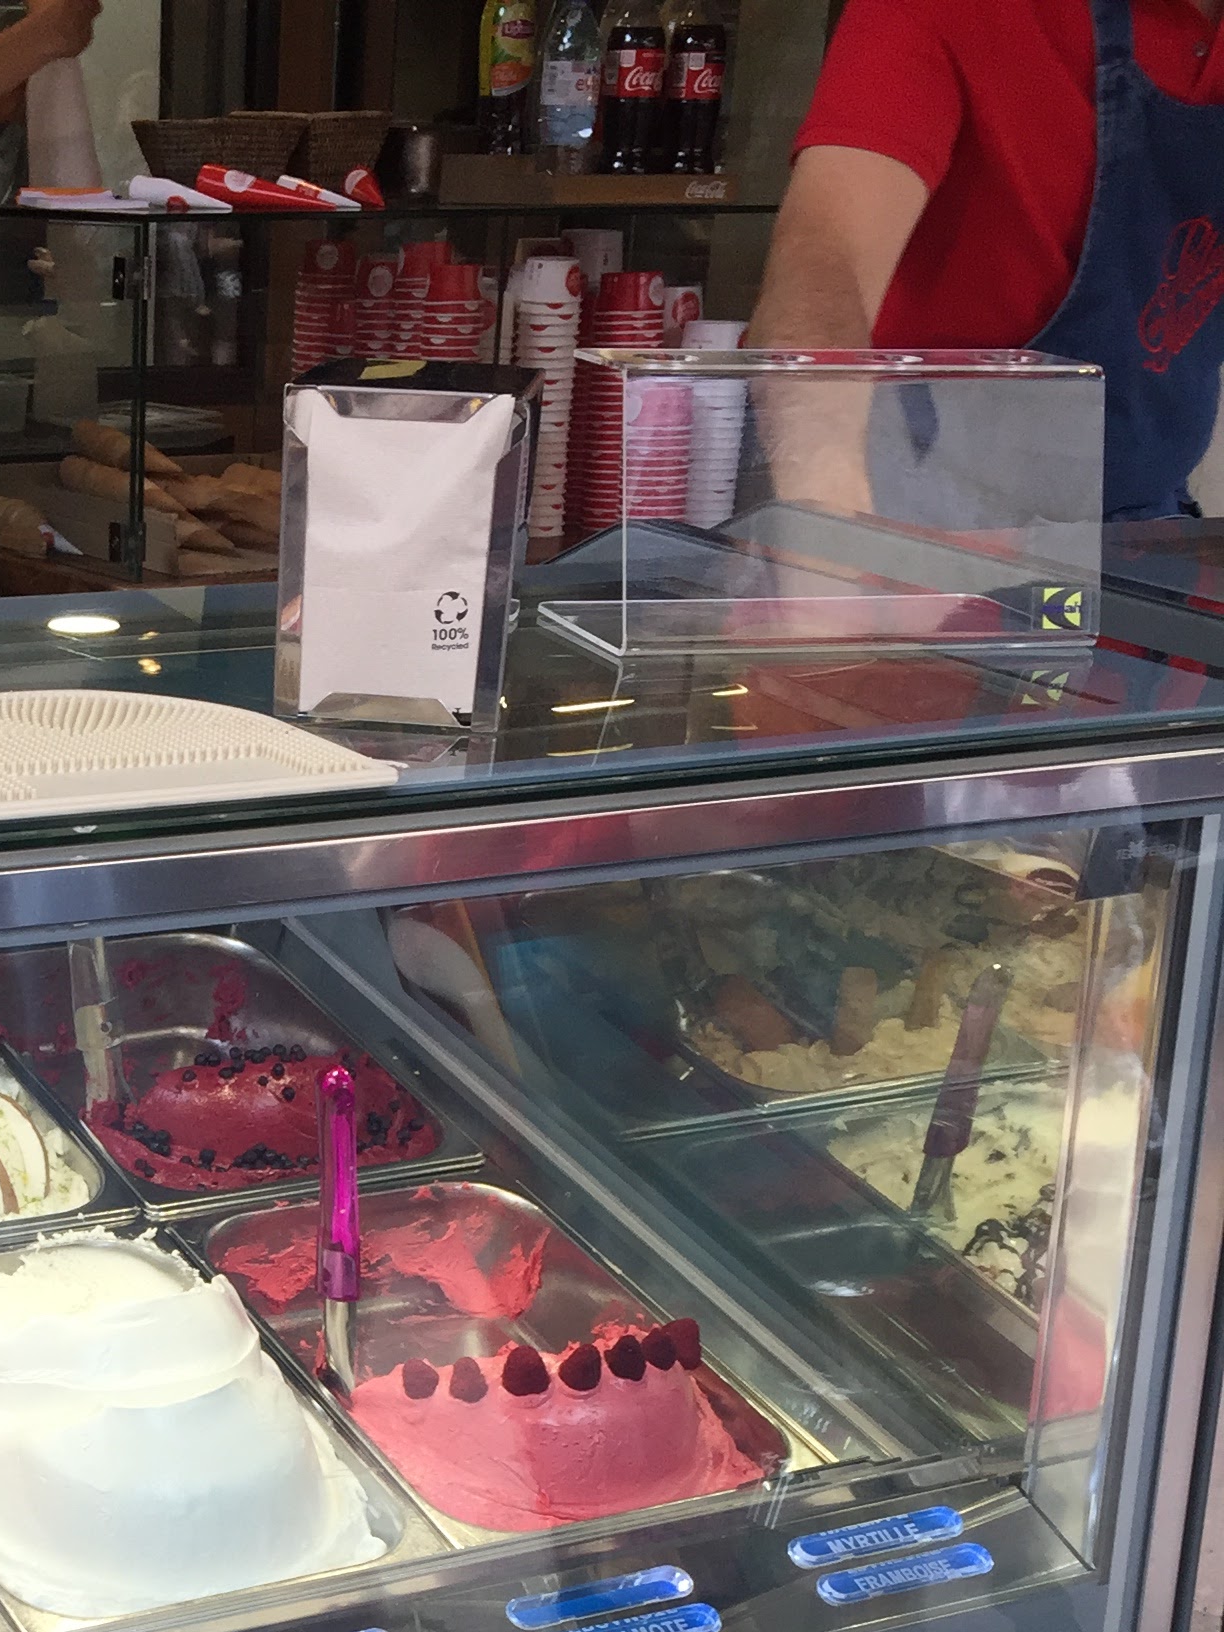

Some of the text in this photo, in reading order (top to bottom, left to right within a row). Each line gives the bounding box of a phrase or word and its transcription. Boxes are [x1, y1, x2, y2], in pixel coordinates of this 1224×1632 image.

[432, 627, 469, 641] 100%
[431, 642, 469, 651] Recycled
[826, 1522, 920, 1554] MYRTILLE
[853, 1558, 951, 1593] FRAMBOISE
